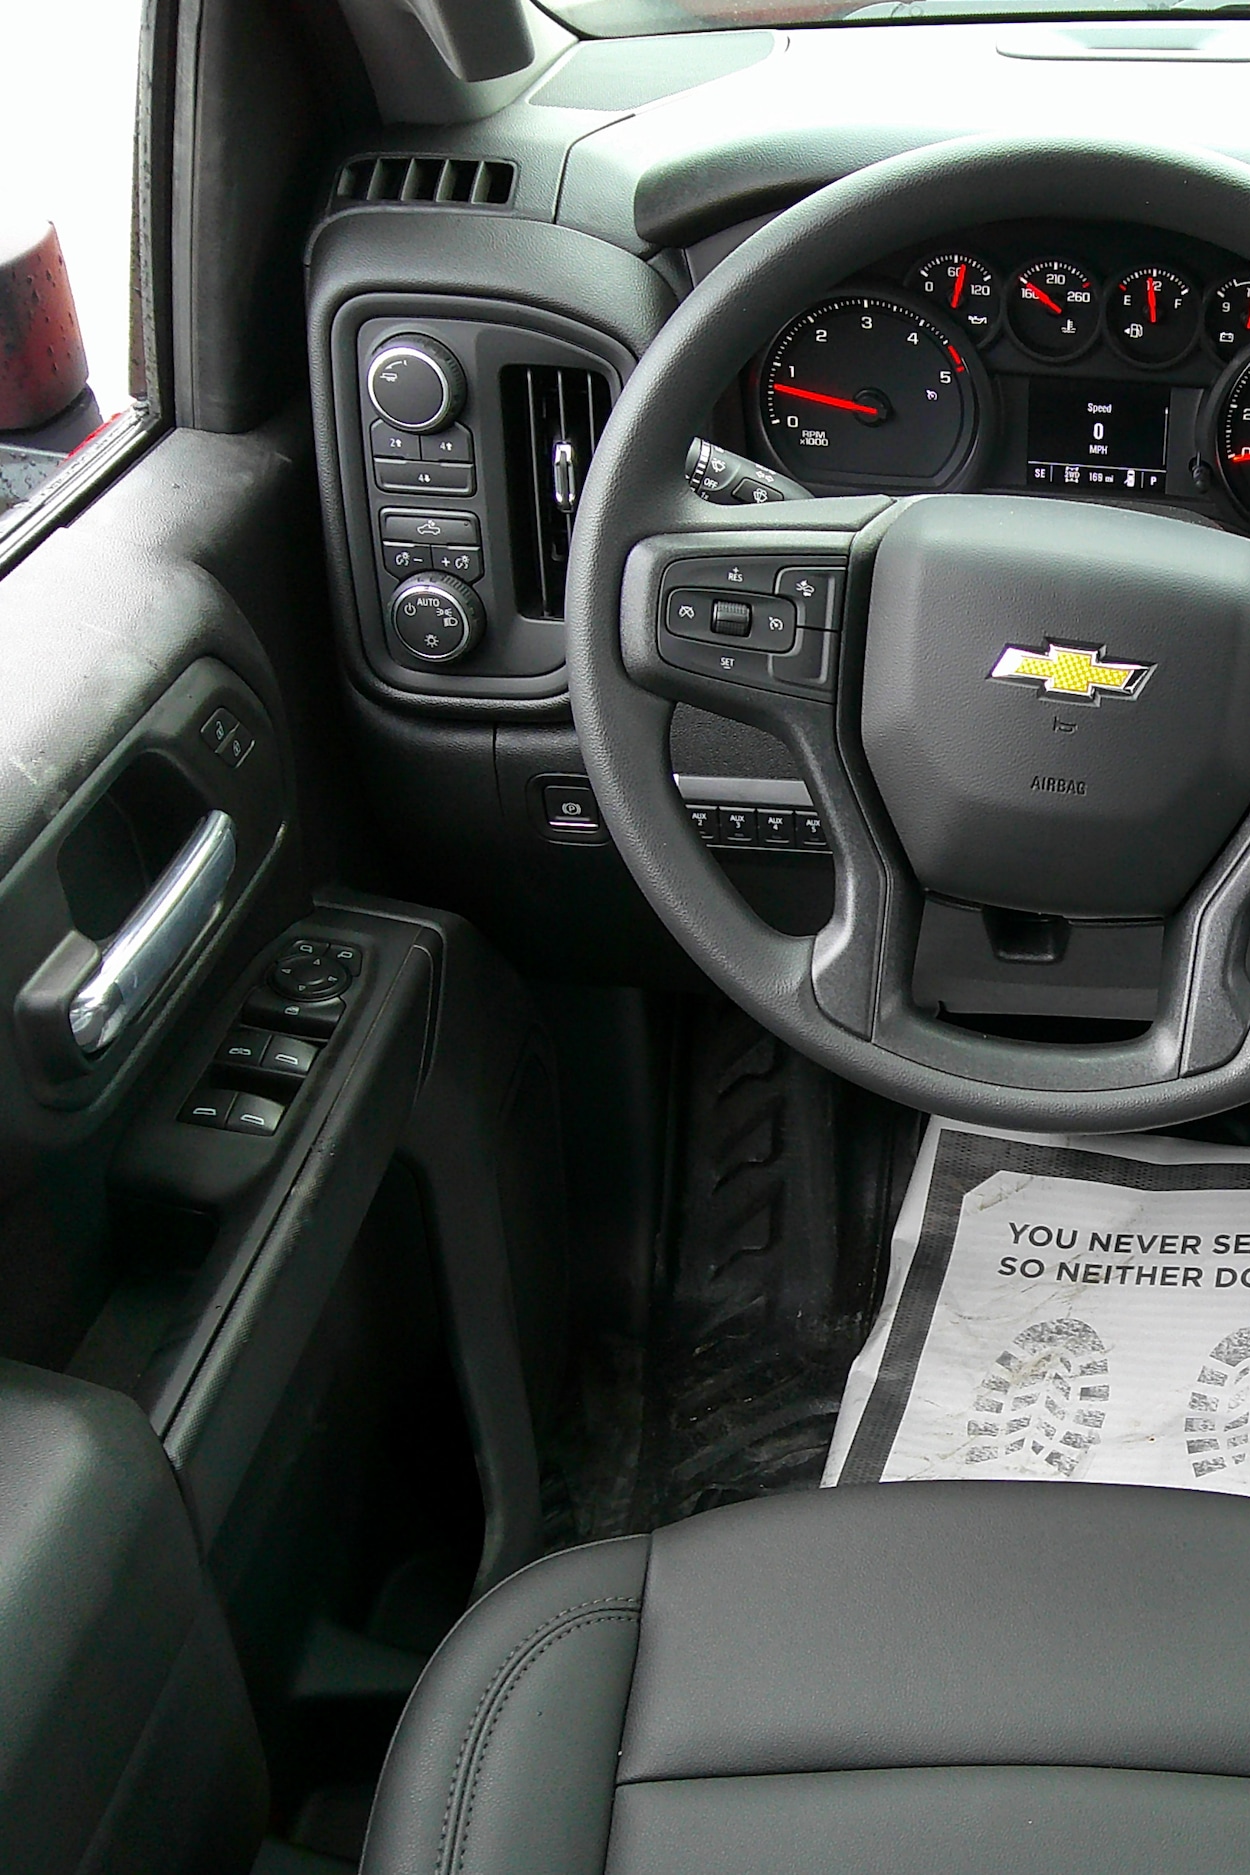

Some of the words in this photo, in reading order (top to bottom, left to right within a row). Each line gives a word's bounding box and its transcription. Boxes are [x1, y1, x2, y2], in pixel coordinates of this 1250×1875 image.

[1046, 274, 1066, 285] 210
[924, 281, 934, 292] 0
[970, 284, 990, 296] 120
[1067, 292, 1090, 302] 260
[1124, 295, 1132, 306] E
[1175, 298, 1182, 308] F
[1222, 302, 1230, 312] 9
[861, 317, 872, 328] 3
[816, 330, 828, 342] 2
[906, 332, 919, 344] 4
[788, 366, 796, 378] 1
[940, 371, 951, 384] 5
[1088, 402, 1112, 414] Speed
[787, 416, 798, 428] 0
[802, 430, 826, 438] RPM
[1093, 422, 1104, 440] 0
[800, 437, 828, 446] x1000
[1089, 445, 1108, 455] MPH
[1034, 468, 1046, 478] SE
[704, 478, 718, 488] OFF
[1150, 476, 1157, 486] P
[728, 572, 743, 582] RES
[416, 598, 440, 608] AUTO
[720, 658, 735, 667] SET
[1030, 776, 1088, 796] AIRBAG
[692, 812, 707, 820] AUX
[730, 814, 745, 822] AUX
[768, 816, 783, 825] AUX
[806, 819, 821, 828] AUX
[1008, 1222, 1078, 1250] YOU
[1088, 1232, 1202, 1255] NEVER
[997, 1256, 1045, 1279] SO
[1056, 1262, 1203, 1288] NEITHER
